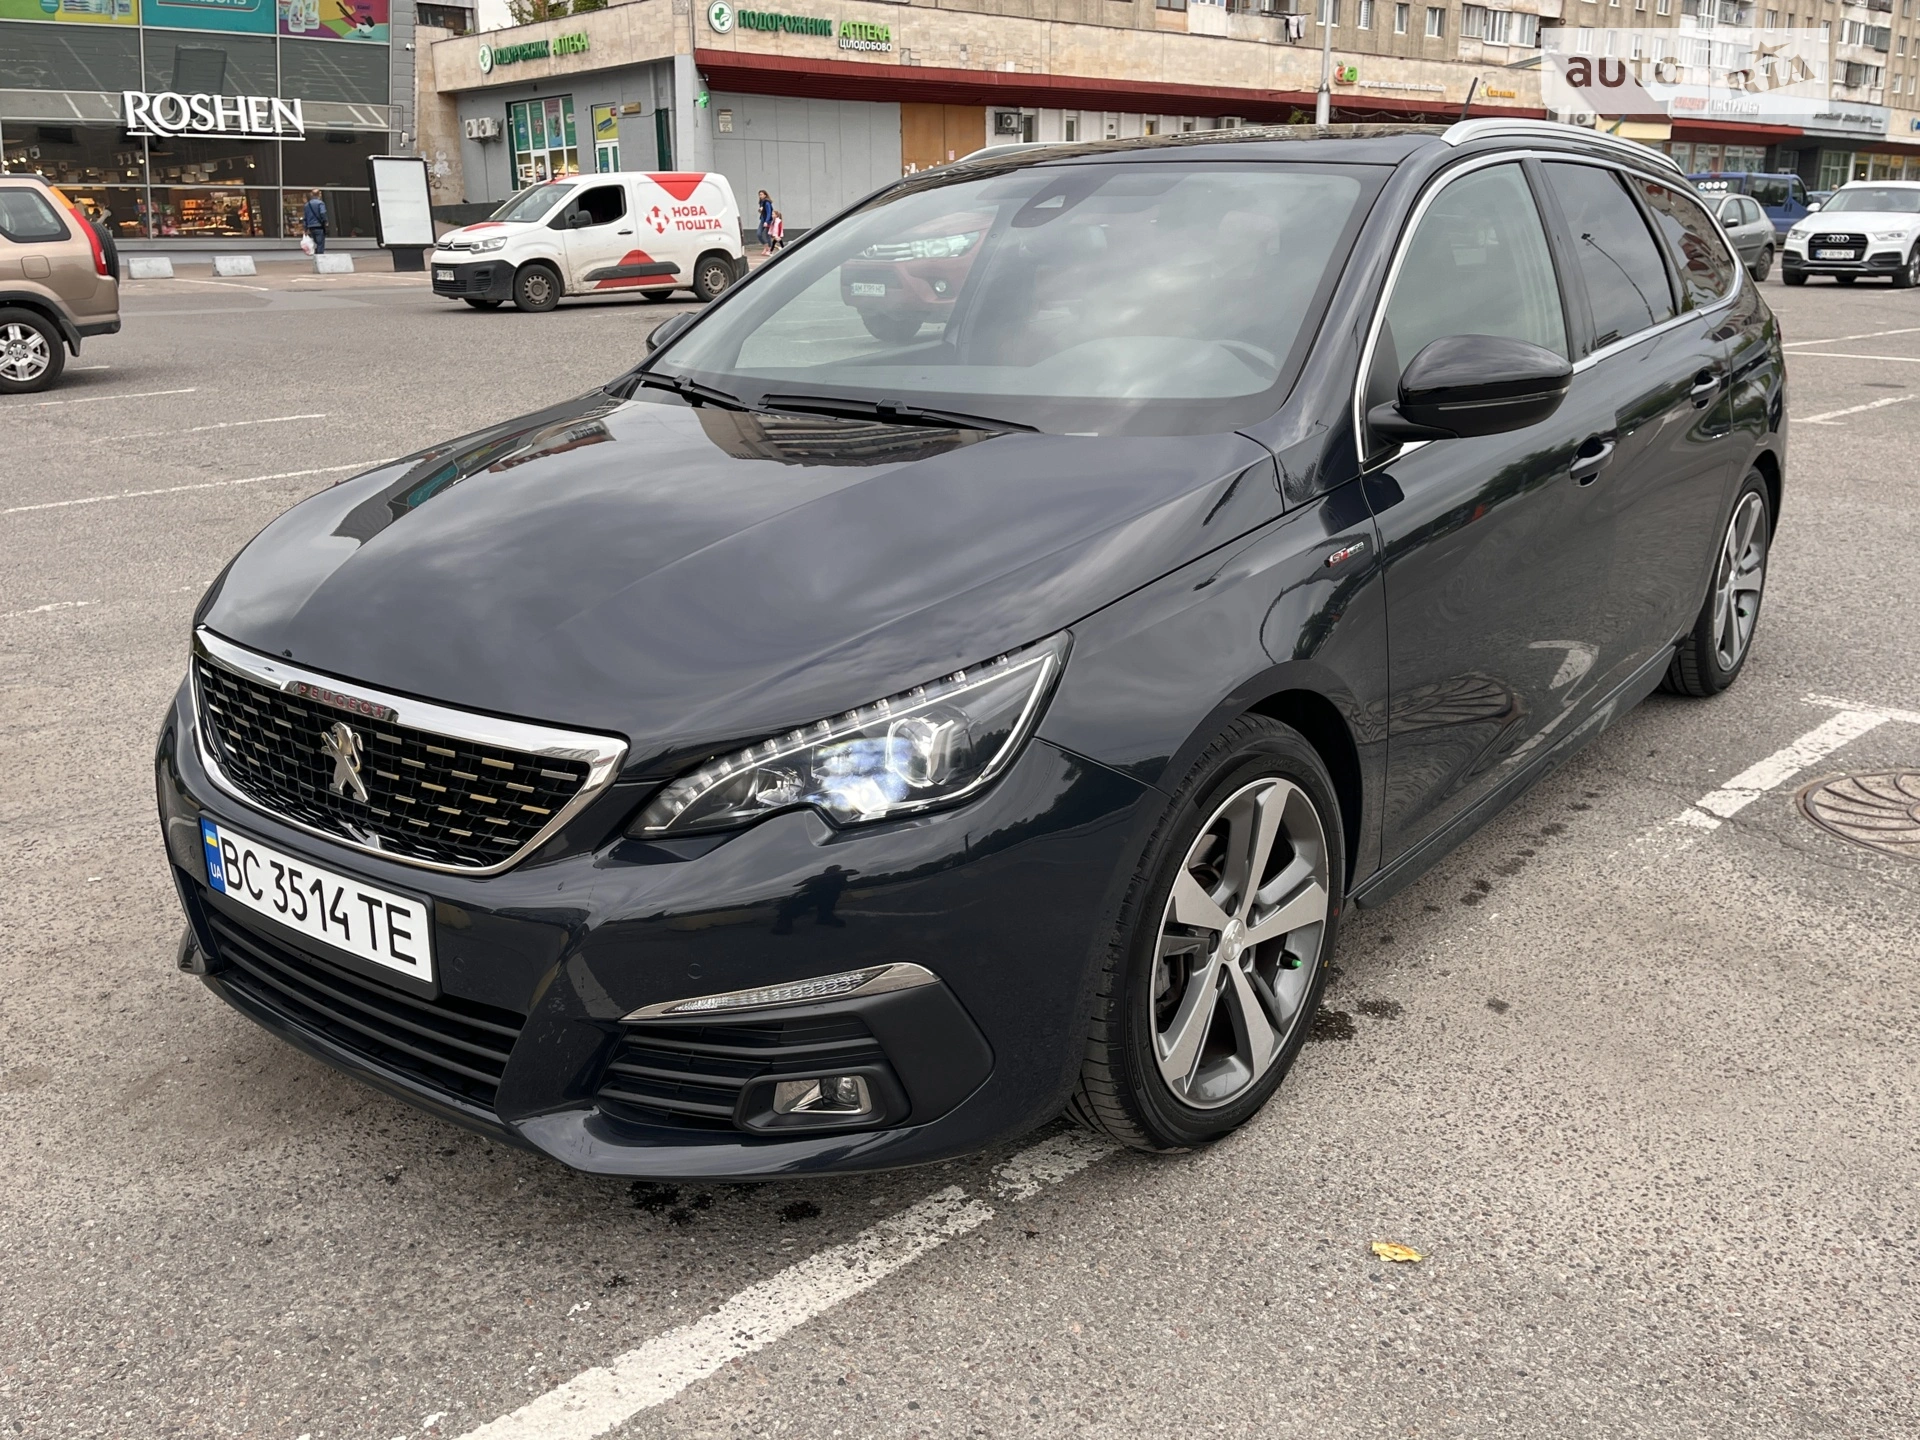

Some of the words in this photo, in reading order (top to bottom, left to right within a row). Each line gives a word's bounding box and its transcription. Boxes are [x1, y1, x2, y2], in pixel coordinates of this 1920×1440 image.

[738, 9, 833, 37] ПОДОРОЖНИК
[838, 21, 892, 42] АПТЕКА
[494, 40, 550, 65] ПОДОРОЖНИК
[552, 31, 590, 56] АПТЕКА
[839, 38, 893, 52] ЦІЛОДОБОВО
[122, 89, 306, 139] ROSHEN
[671, 205, 708, 218] НОВА
[675, 218, 723, 231] ПОШТА
[298, 683, 385, 717] PEUGEOT
[210, 862, 223, 882] UA
[220, 836, 264, 901] BC
[269, 859, 351, 942] 3514
[357, 892, 417, 966] TE
